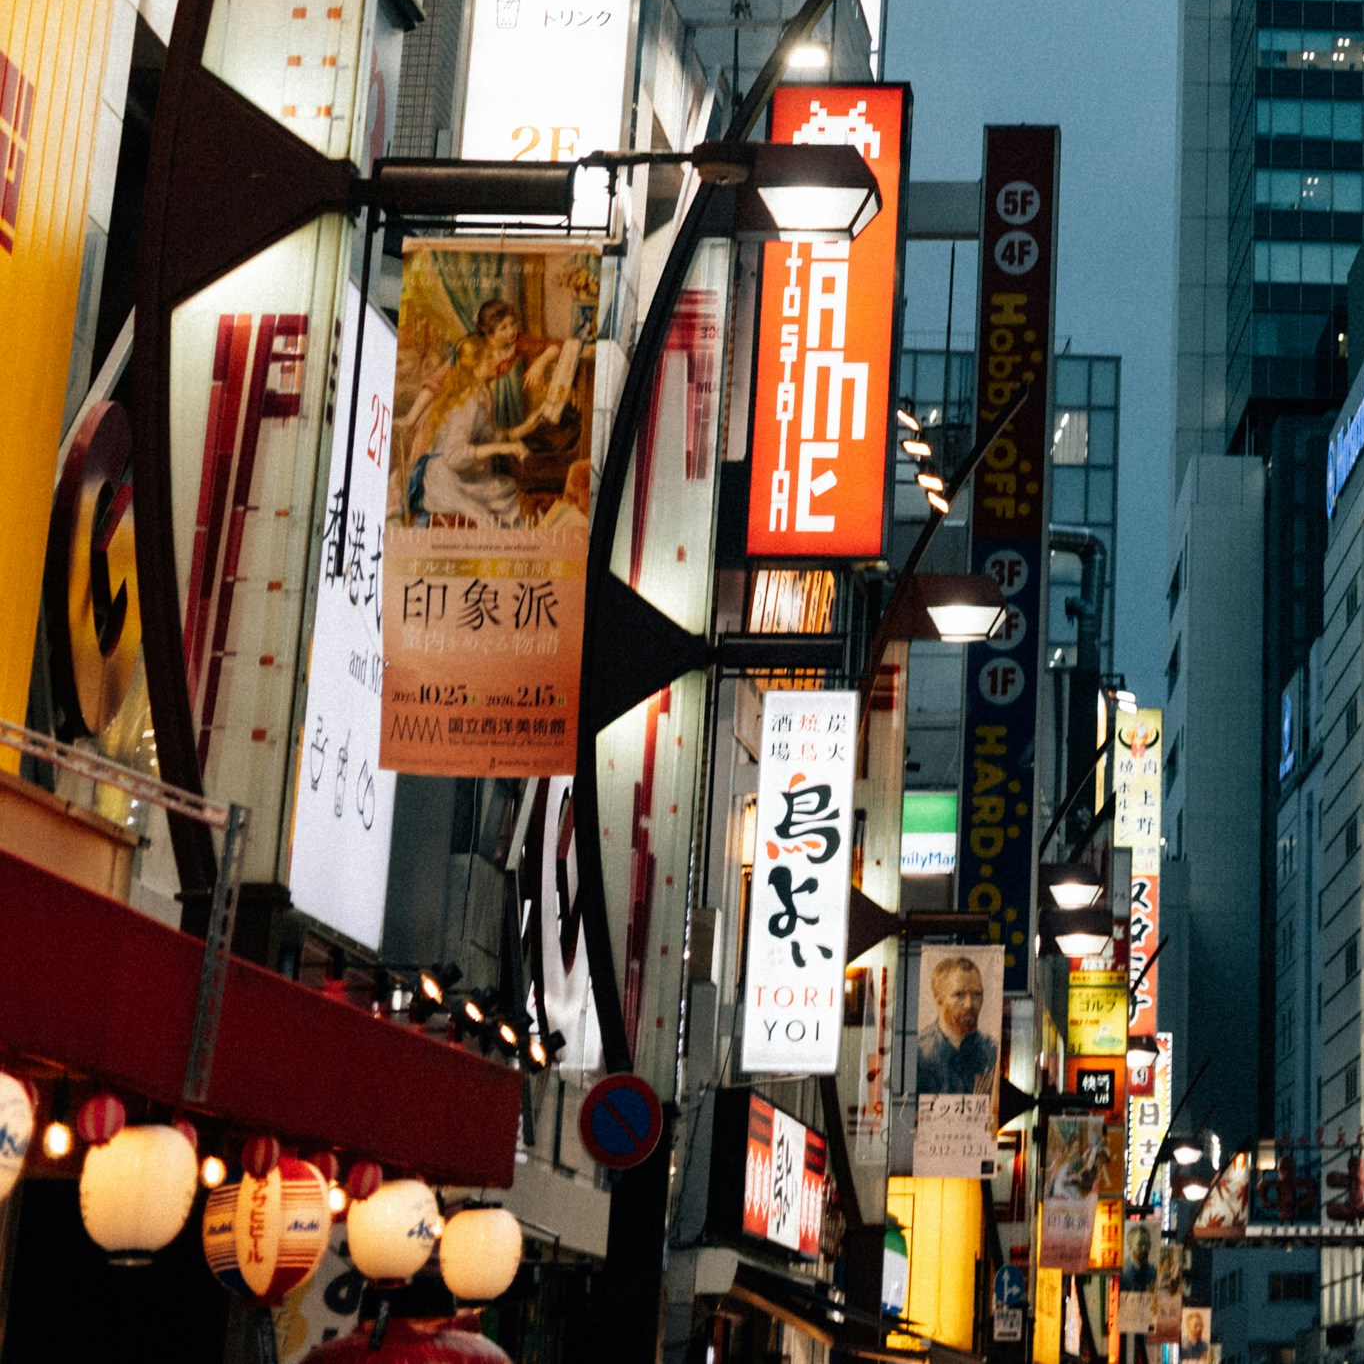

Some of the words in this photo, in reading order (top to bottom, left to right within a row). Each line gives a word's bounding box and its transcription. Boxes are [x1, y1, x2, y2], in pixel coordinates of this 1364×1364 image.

[511, 125, 581, 162] 2F
[1003, 190, 1034, 216] 5F
[1000, 239, 1032, 266] 4F
[795, 240, 869, 532] AME
[990, 558, 1022, 589] 3F
[402, 577, 558, 631] 印象派
[985, 665, 1016, 695] 1F
[448, 717, 566, 735] 国立西洋美術館
[766, 772, 841, 968] 鳥よい
[754, 985, 834, 1008] TORI
[1079, 1000, 1116, 1013] ゴルフ
[763, 1019, 821, 1041] YOI
